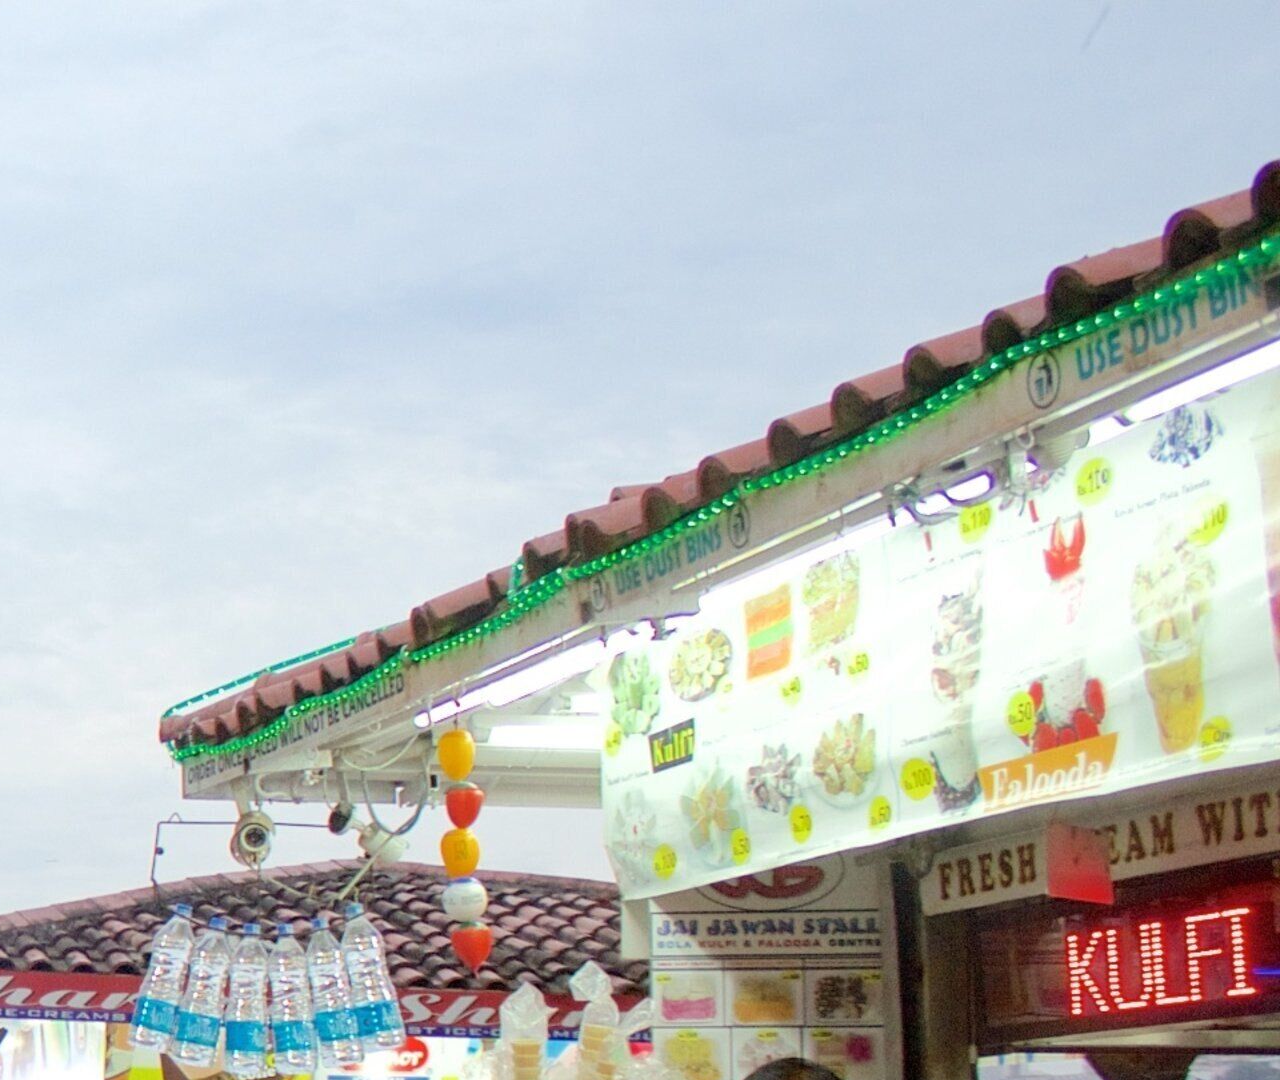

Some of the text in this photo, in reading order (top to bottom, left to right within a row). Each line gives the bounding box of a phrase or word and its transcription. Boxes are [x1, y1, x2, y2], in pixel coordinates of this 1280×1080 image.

[1075, 330, 1124, 381] USE
[1130, 295, 1198, 354] DUST
[612, 522, 723, 595] USE DUST BINS
[304, 711, 325, 734] NOT
[343, 672, 405, 718] CANCELLED
[652, 727, 695, 768] Kulfi
[989, 752, 1106, 804] Falooda
[938, 842, 1037, 900] FRESH
[1195, 793, 1280, 847] WIT
[657, 917, 879, 936] JAI JAWAN STALL
[1066, 906, 1256, 1015] KULFI
